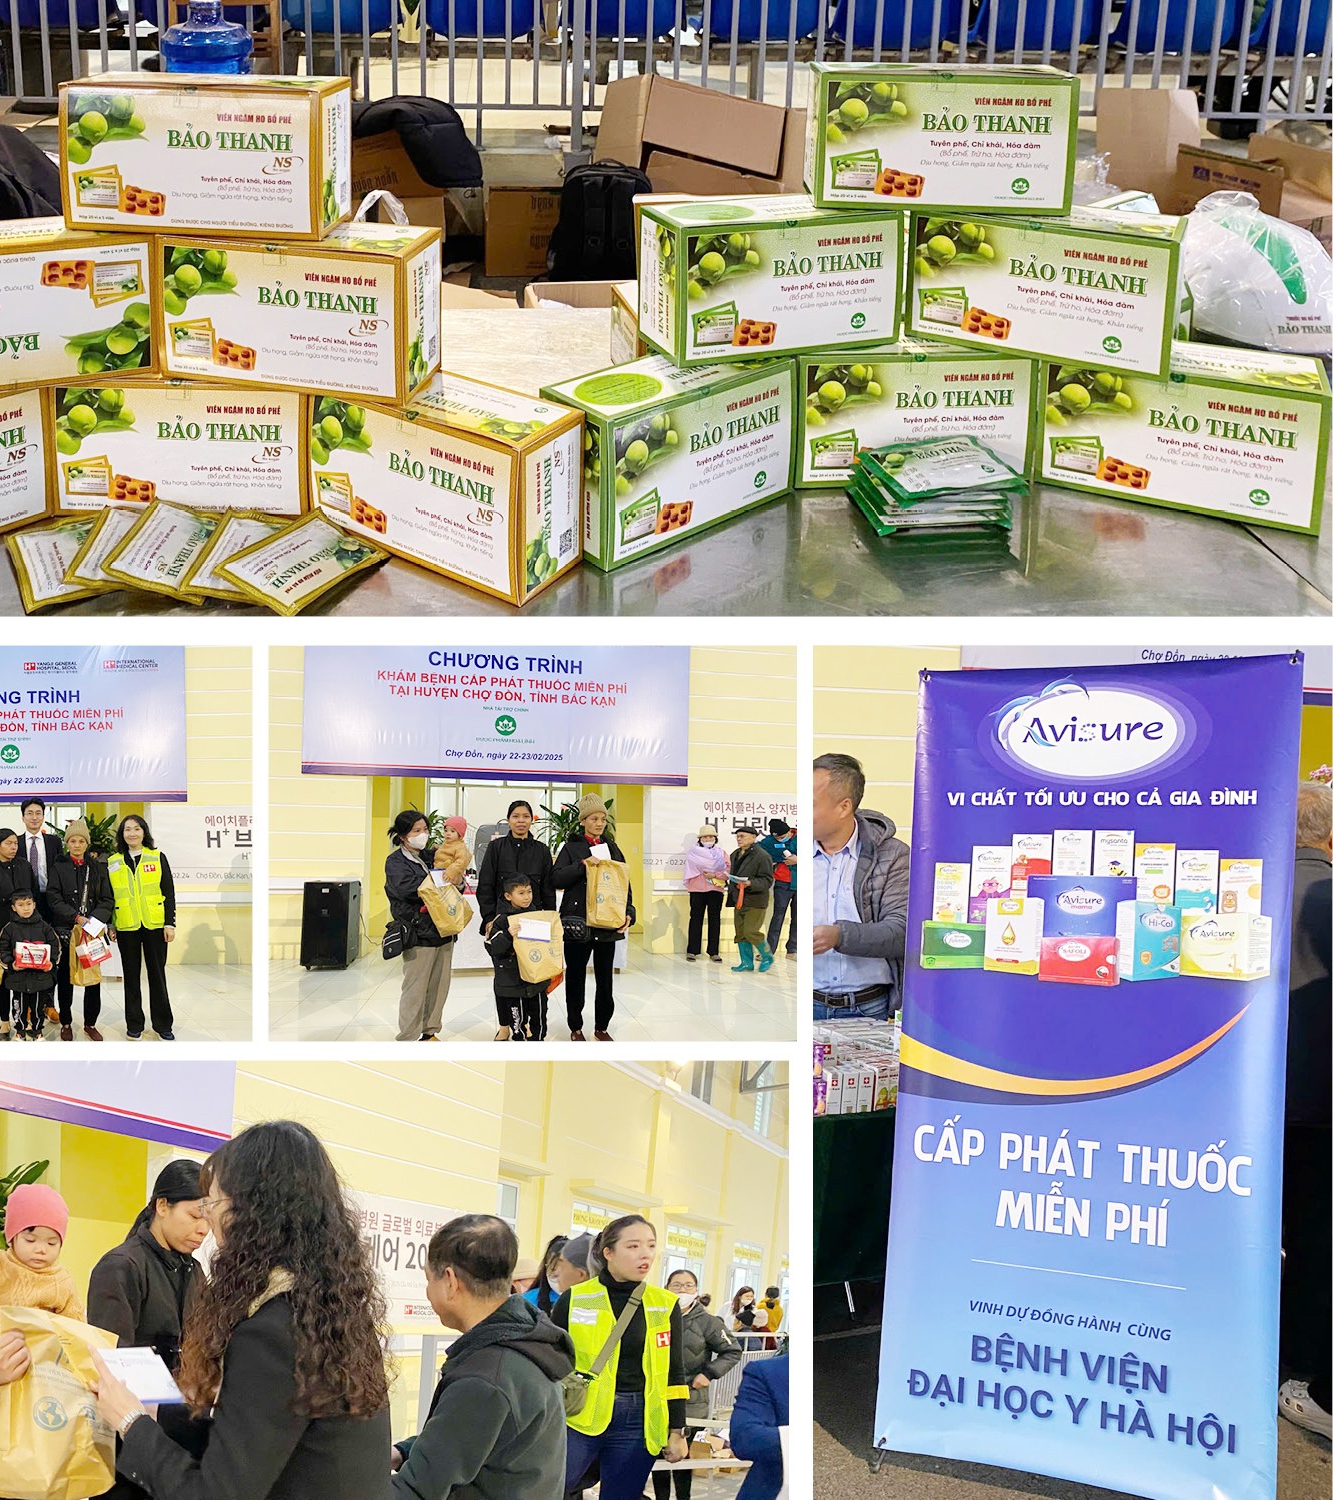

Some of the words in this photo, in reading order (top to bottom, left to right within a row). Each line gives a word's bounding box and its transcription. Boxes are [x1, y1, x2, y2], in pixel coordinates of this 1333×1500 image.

[922, 106, 969, 132] BẢO
[973, 116, 1052, 134] THANH
[167, 123, 211, 149] BẢO
[216, 132, 292, 152] THANH
[273, 156, 292, 168] NS
[773, 252, 812, 278] BẢO
[817, 251, 883, 273] THANH
[1010, 254, 1057, 282] BẢO
[1062, 267, 1147, 297] THANH
[896, 384, 937, 409] BẢO
[943, 389, 1013, 407] THANH
[157, 415, 201, 439] BẢO
[206, 423, 282, 443] THANH
[1148, 404, 1199, 433] BẢO
[1206, 418, 1297, 450] THANH
[389, 449, 425, 481] BẢO
[429, 465, 495, 505] THANH
[428, 651, 519, 671] CHƯƠNG
[526, 655, 582, 675] TRÌNH
[27, 687, 80, 704] TRÌNH
[1021, 715, 1164, 746] Avisure
[948, 791, 965, 806] VI
[972, 787, 1017, 807] CHẤT
[1024, 788, 1053, 807] TỐI
[1059, 789, 1088, 806] ƯU
[1094, 791, 1129, 806] CHO
[1137, 786, 1162, 806] CẢ
[1170, 790, 1201, 806] GIA
[1210, 787, 1257, 806] ĐÌNH
[1148, 918, 1173, 928] Hi-Cal
[914, 1114, 984, 1166] CẤP
[999, 1128, 1100, 1179] PHÁT
[1118, 1139, 1252, 1197] THUỐC
[382, 1213, 412, 1235] 글로벌
[995, 1181, 1090, 1238] MIỄN
[1106, 1198, 1170, 1247] PHÍ
[969, 1300, 1003, 1317] VINH
[1006, 1305, 1030, 1322] DỰ
[1031, 1307, 1074, 1326] ĐỒNG
[1078, 1314, 1120, 1333] HÀNH
[1128, 1322, 1172, 1341] CÙNG
[971, 1332, 1067, 1376] BỆNH
[1080, 1351, 1167, 1394] VIỆN
[907, 1369, 964, 1408] ĐẠI
[977, 1379, 1053, 1420] HỌC
[1065, 1394, 1088, 1425] Y
[1100, 1400, 1155, 1439] HÀ
[1167, 1413, 1235, 1457] HỘI
